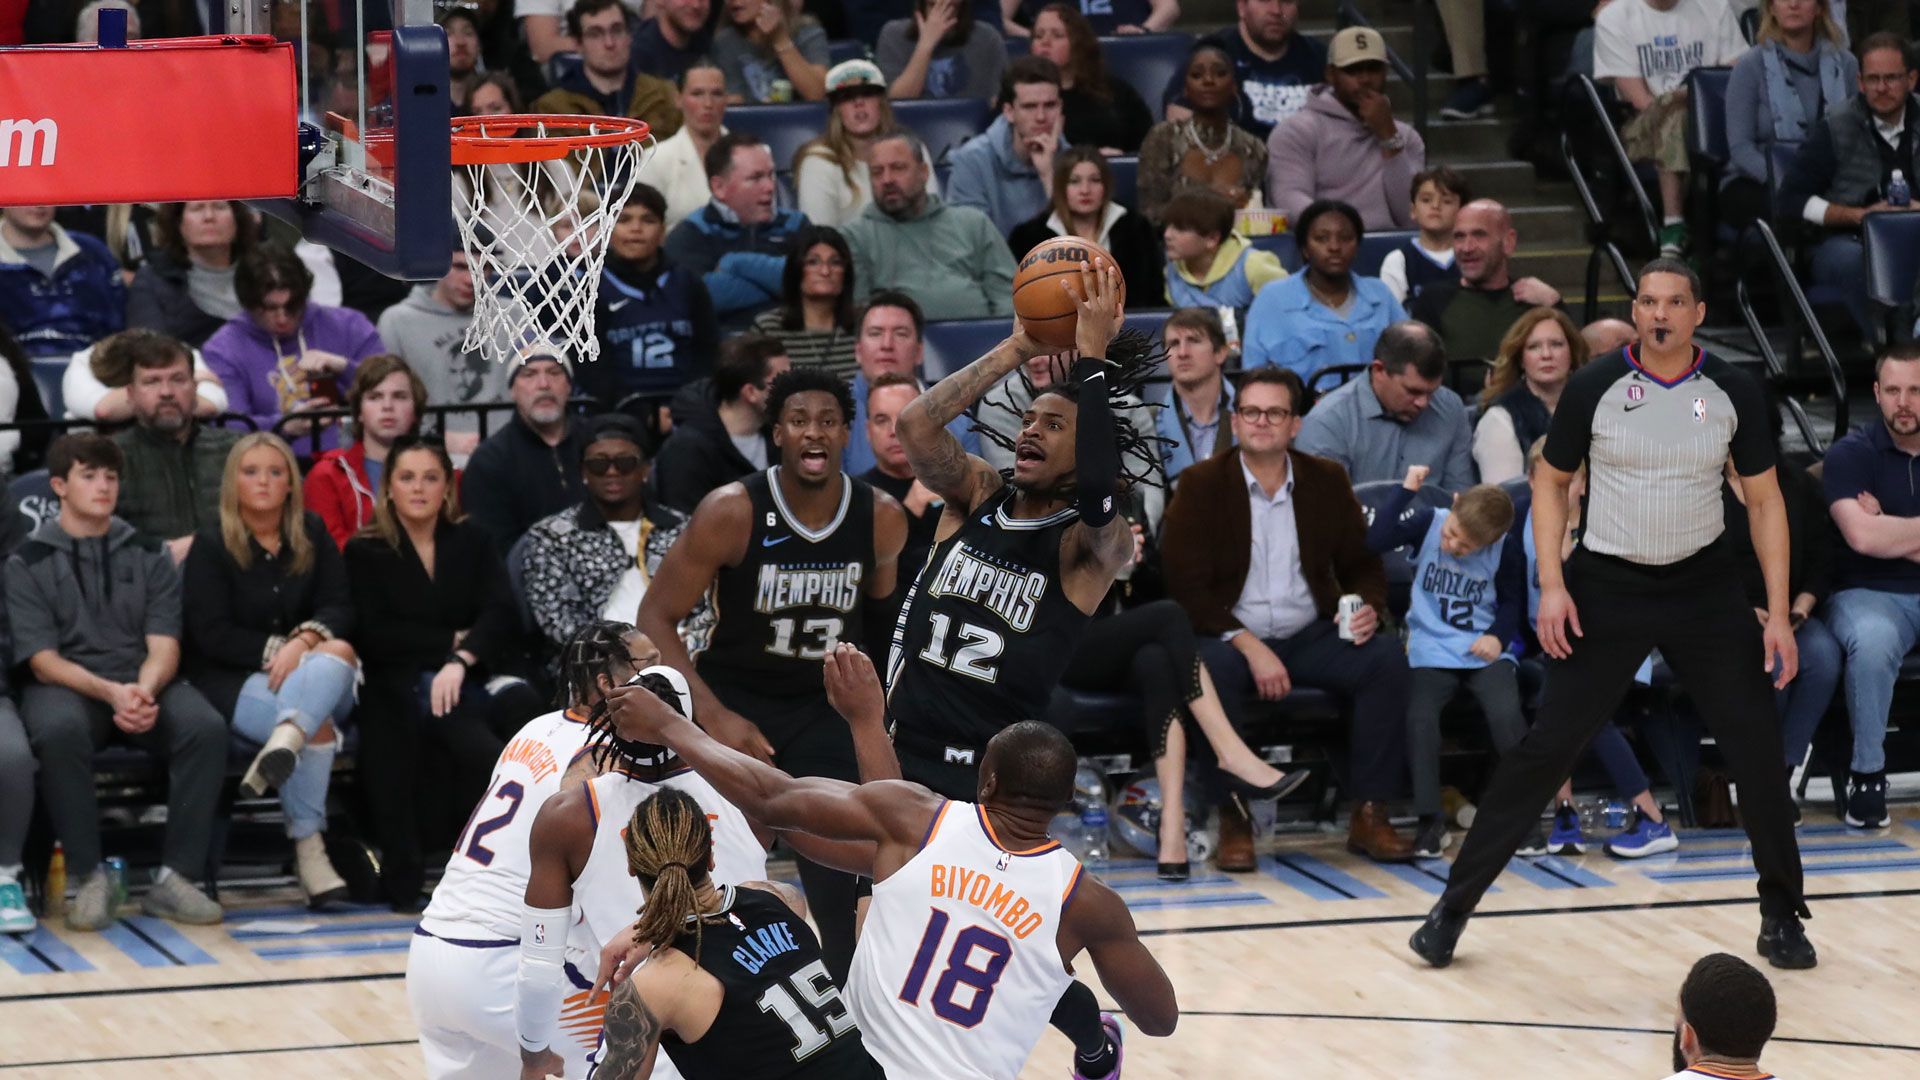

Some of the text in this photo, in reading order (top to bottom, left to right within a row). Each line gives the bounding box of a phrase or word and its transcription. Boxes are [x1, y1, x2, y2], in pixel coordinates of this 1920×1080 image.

[1355, 34, 1369, 50] S
[631, 333, 675, 368] 12
[766, 511, 777, 527] 6
[754, 561, 863, 614] MEMPHIS
[928, 540, 1048, 632] MEMPHIS
[765, 617, 844, 660] 13
[1440, 597, 1474, 632] 12
[919, 610, 1005, 684] 12
[944, 746, 975, 765] M
[453, 774, 524, 867] 12
[931, 864, 1043, 940] BIYOMBO
[732, 921, 800, 976] CLARKE
[898, 905, 1013, 1029] 18
[756, 958, 857, 1062] 15
